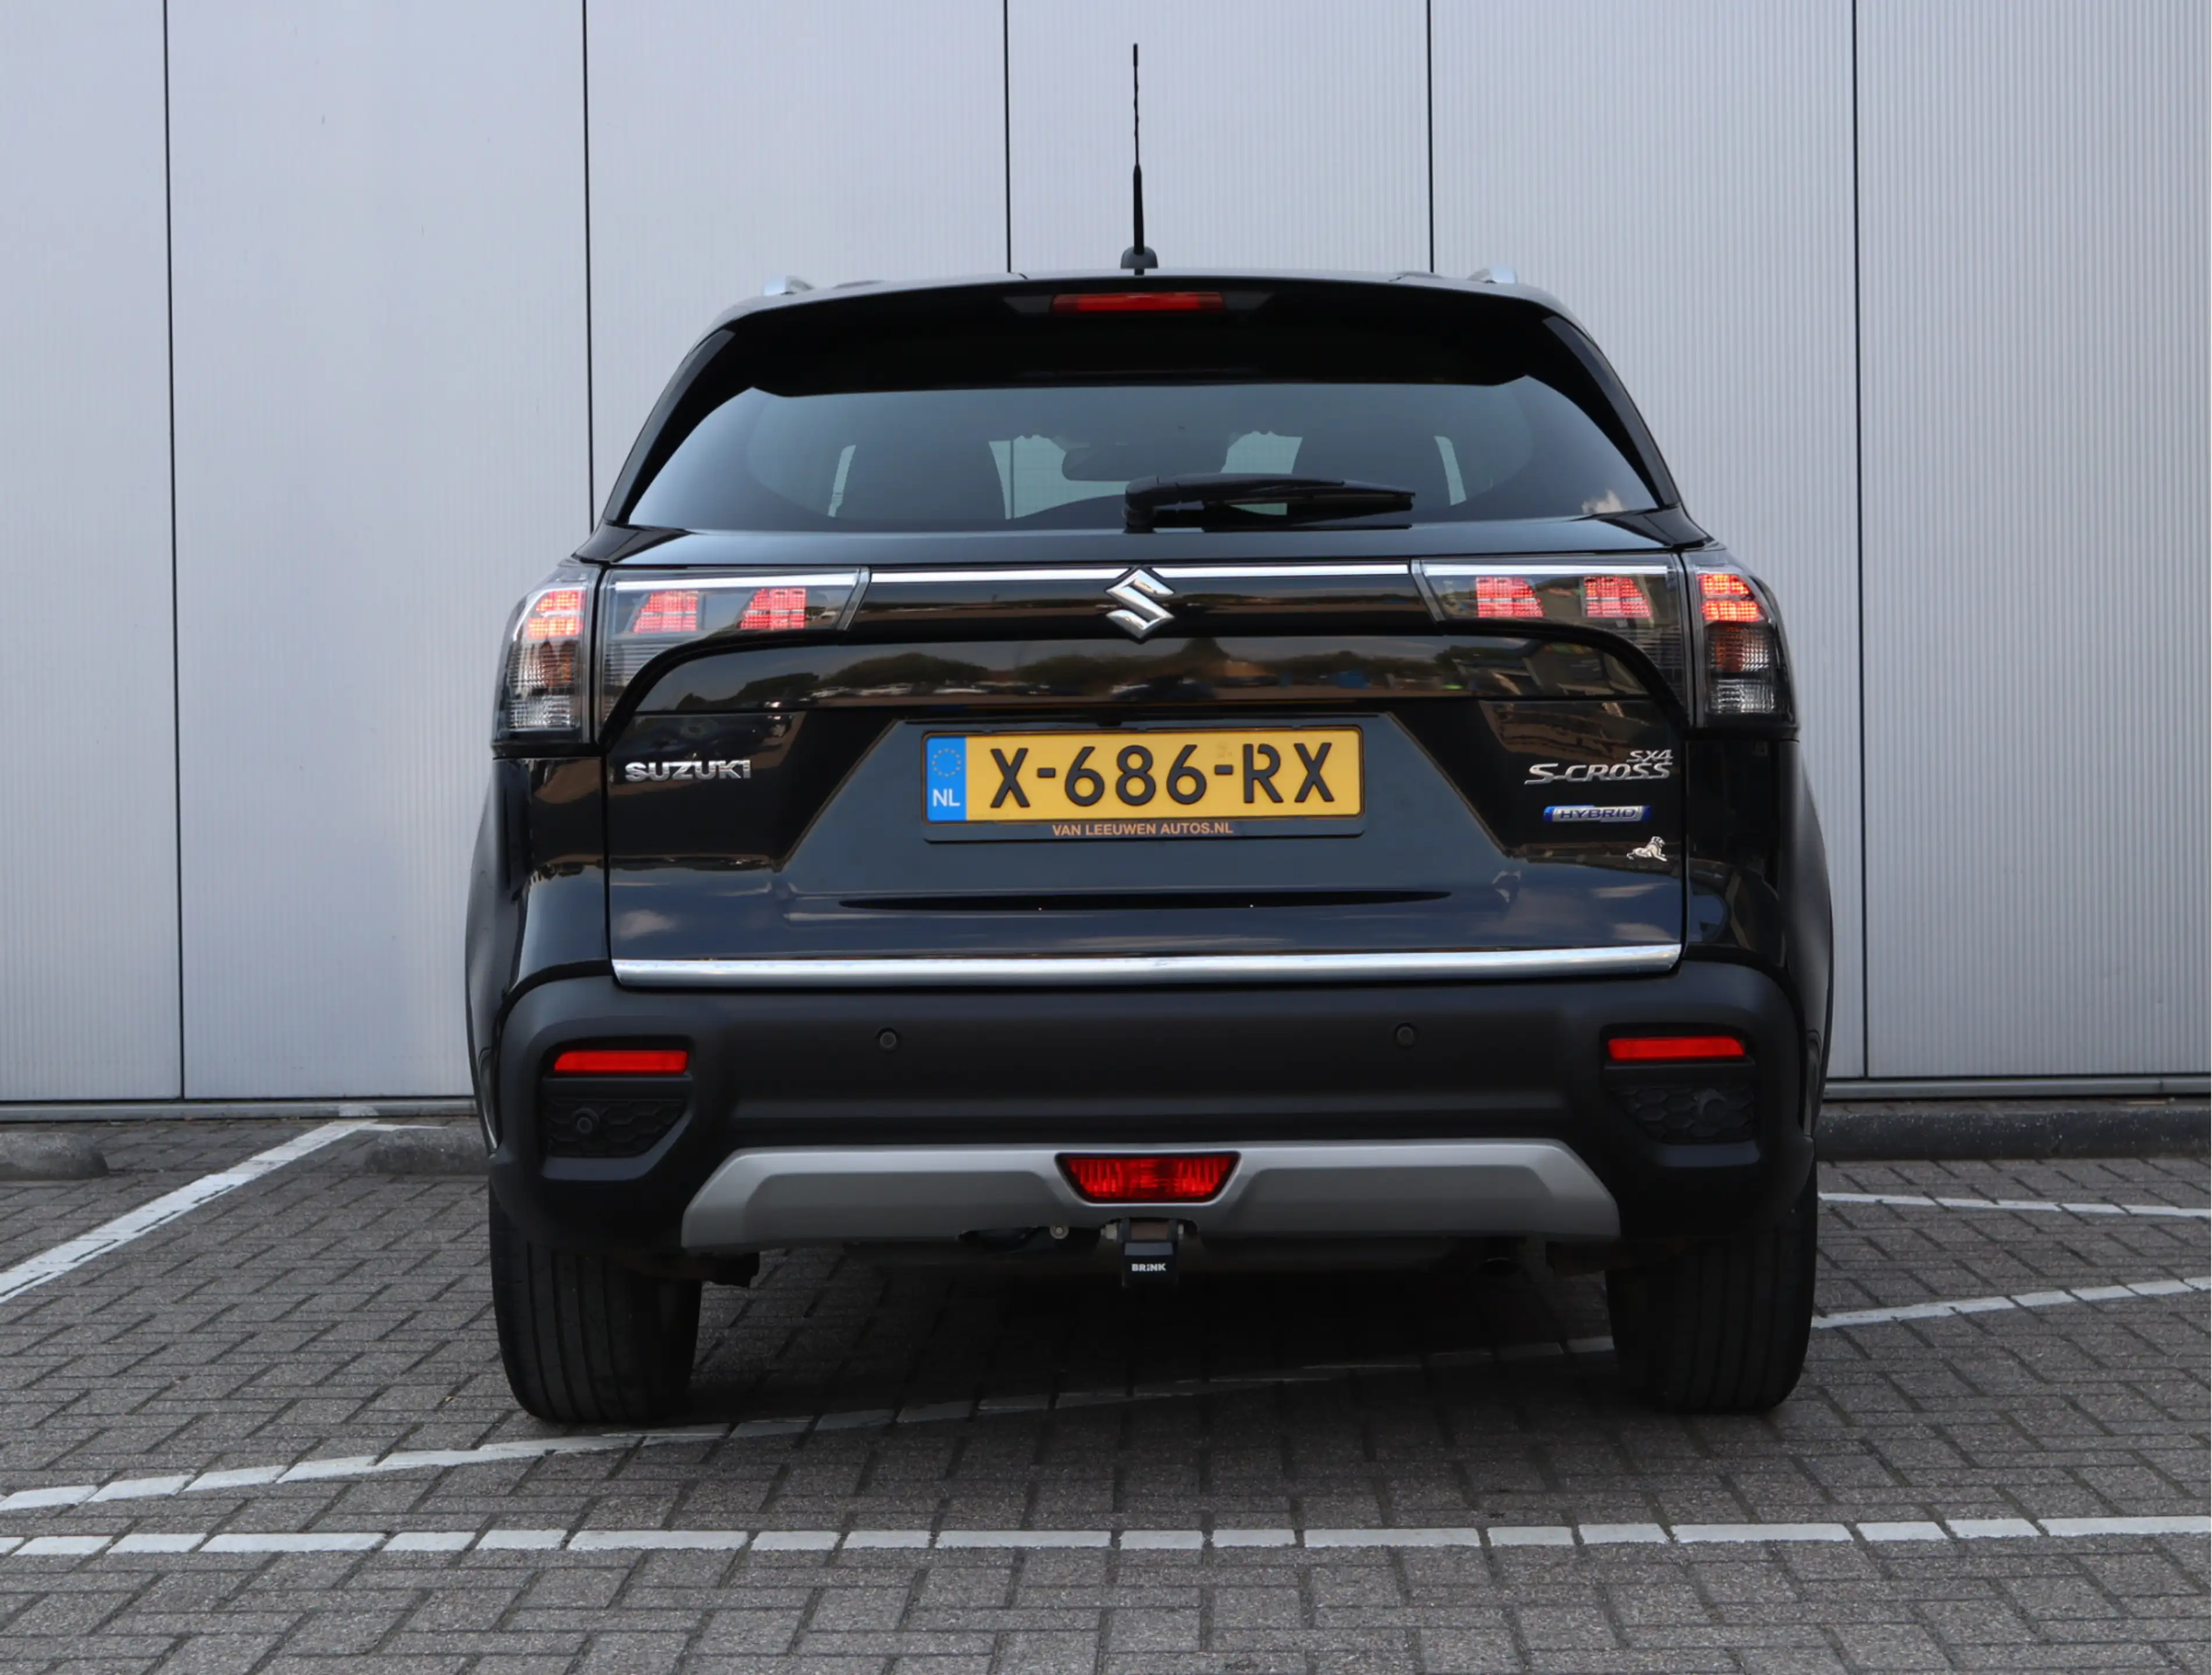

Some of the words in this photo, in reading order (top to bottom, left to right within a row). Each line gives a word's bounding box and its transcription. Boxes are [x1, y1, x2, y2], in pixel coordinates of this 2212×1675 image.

[1626, 749, 1673, 763] SX4
[624, 759, 751, 782] SUZUKI
[990, 742, 1335, 809] X-686-RX
[932, 789, 960, 808] NL
[1559, 808, 1636, 819] HYBRID
[1052, 824, 1081, 836] VAN
[1085, 823, 1157, 836] LEEUWEN
[1160, 822, 1234, 835] AUTOS.NL
